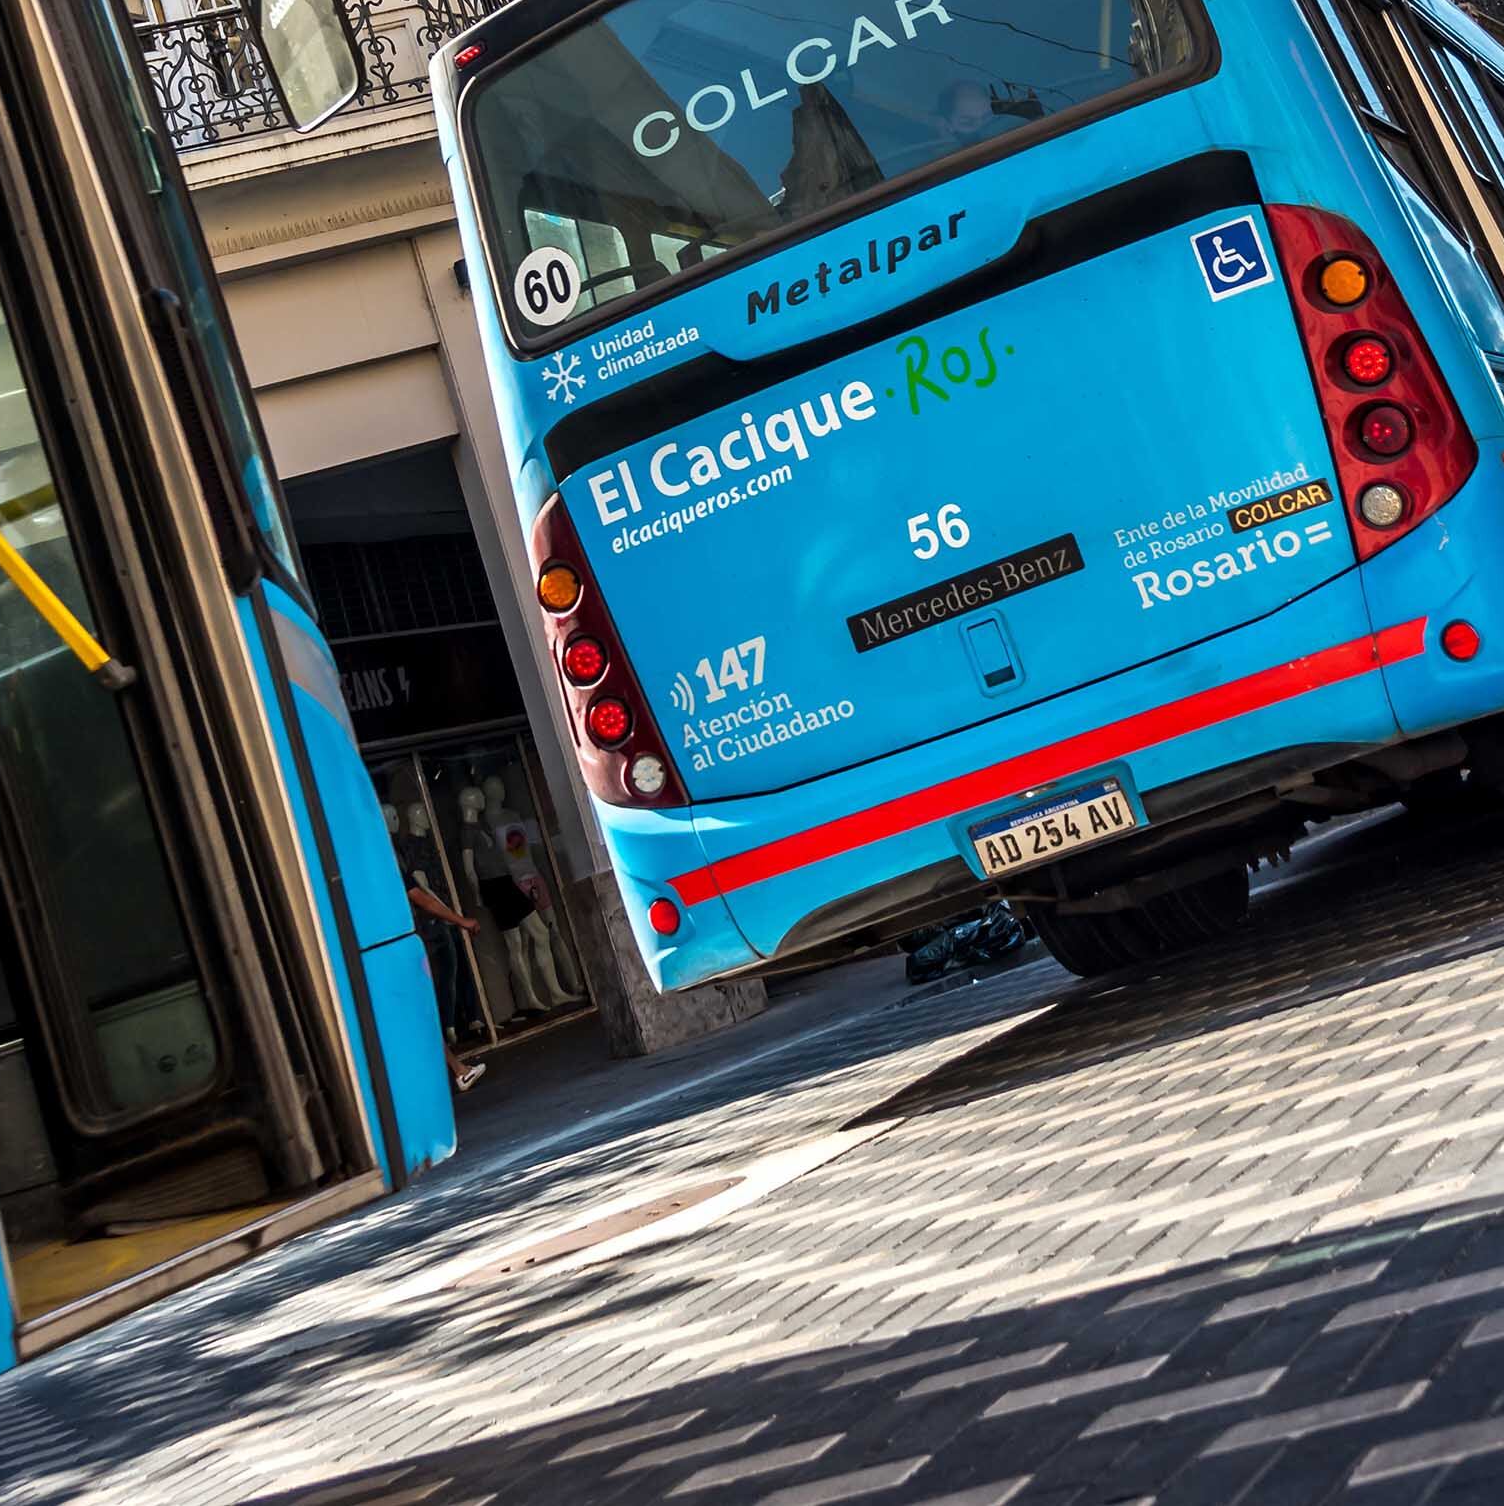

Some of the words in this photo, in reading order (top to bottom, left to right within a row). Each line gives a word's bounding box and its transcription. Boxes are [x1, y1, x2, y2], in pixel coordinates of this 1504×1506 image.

[523, 259, 572, 315] 60
[747, 208, 968, 324] Metalpar
[590, 320, 656, 362] Unidad
[597, 325, 701, 381] climatizada
[588, 459, 642, 527] El
[650, 380, 878, 499] Cacique
[611, 462, 794, 555] elcaciqueros.com
[906, 502, 971, 561] 56
[1113, 519, 1160, 548] Ente
[1162, 511, 1187, 531] de
[1187, 504, 1208, 520] la
[1207, 462, 1310, 514] Movilidad
[1234, 483, 1328, 529] COLCAR
[1123, 551, 1149, 570] de
[1148, 521, 1225, 561] Rosario
[859, 548, 1073, 646] Mercedes-Benz
[695, 634, 766, 704] 147
[681, 690, 793, 749] Atención
[691, 745, 716, 773] al
[717, 698, 856, 762] Ciudadano
[985, 833, 1023, 869] AD
[1025, 812, 1082, 855] 254
[1087, 796, 1125, 834] AV
